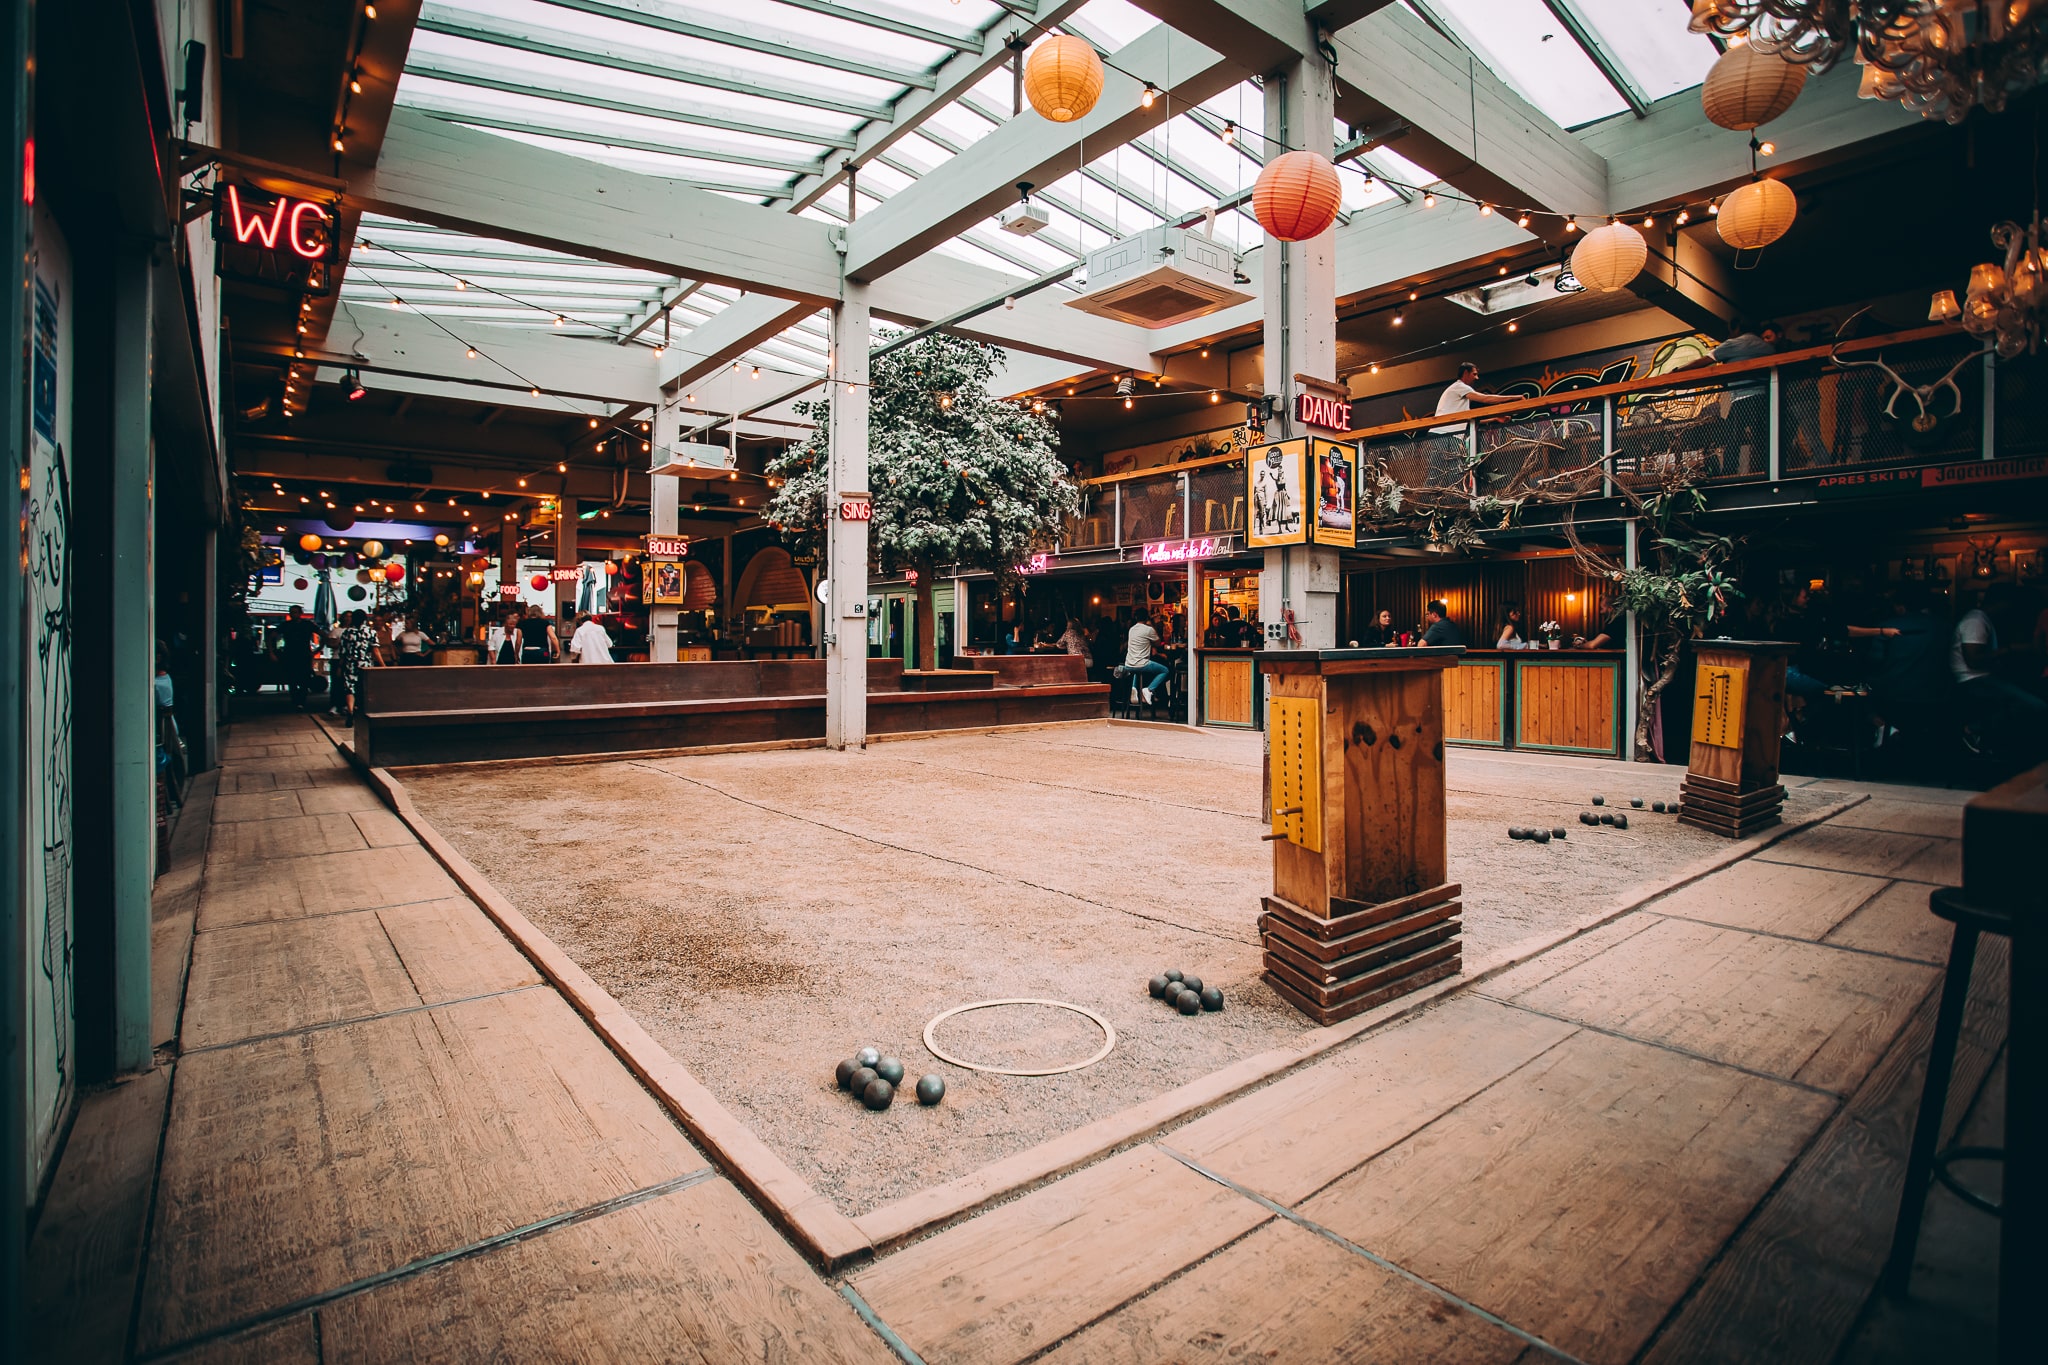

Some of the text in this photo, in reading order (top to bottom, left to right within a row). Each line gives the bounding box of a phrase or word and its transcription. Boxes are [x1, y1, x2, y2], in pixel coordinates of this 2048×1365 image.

[227, 184, 329, 258] WC
[1302, 394, 1352, 431] DANCE
[1818, 470, 1917, 487] APRES SKI BY
[842, 502, 871, 520] SING
[648, 541, 688, 556] BOULES
[553, 567, 584, 581] DRINKS
[500, 585, 520, 595] FOOD
